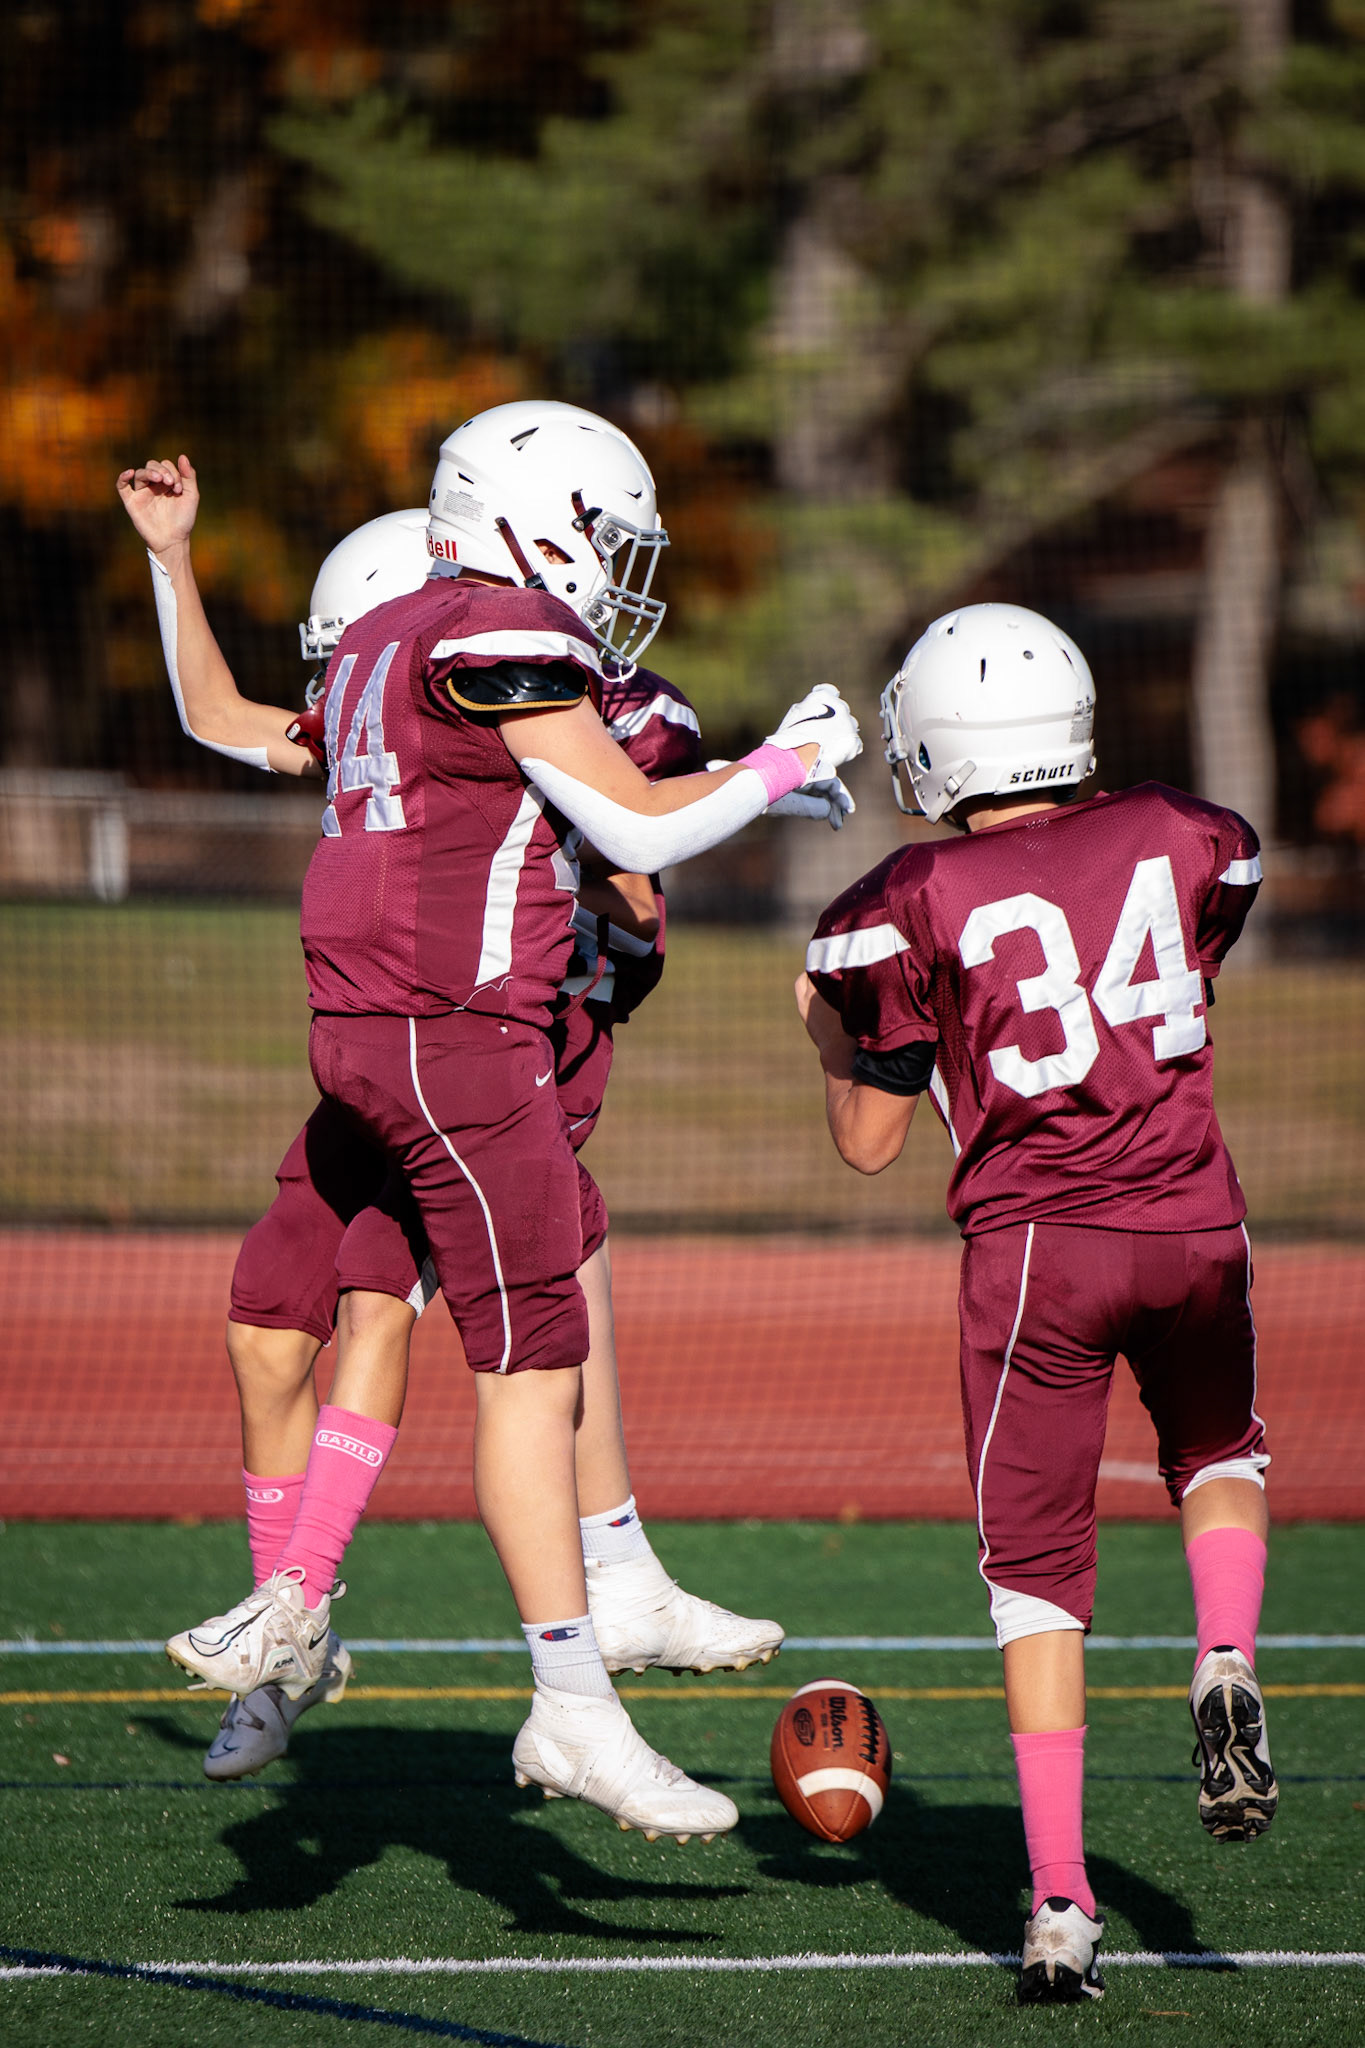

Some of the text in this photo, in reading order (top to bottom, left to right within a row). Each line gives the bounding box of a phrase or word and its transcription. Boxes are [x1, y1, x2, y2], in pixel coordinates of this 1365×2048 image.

[1009, 763, 1075, 784] schutt
[957, 855, 1207, 1098] 34
[319, 1433, 378, 1462] BATTLE
[829, 1696, 847, 1749] Wilson
